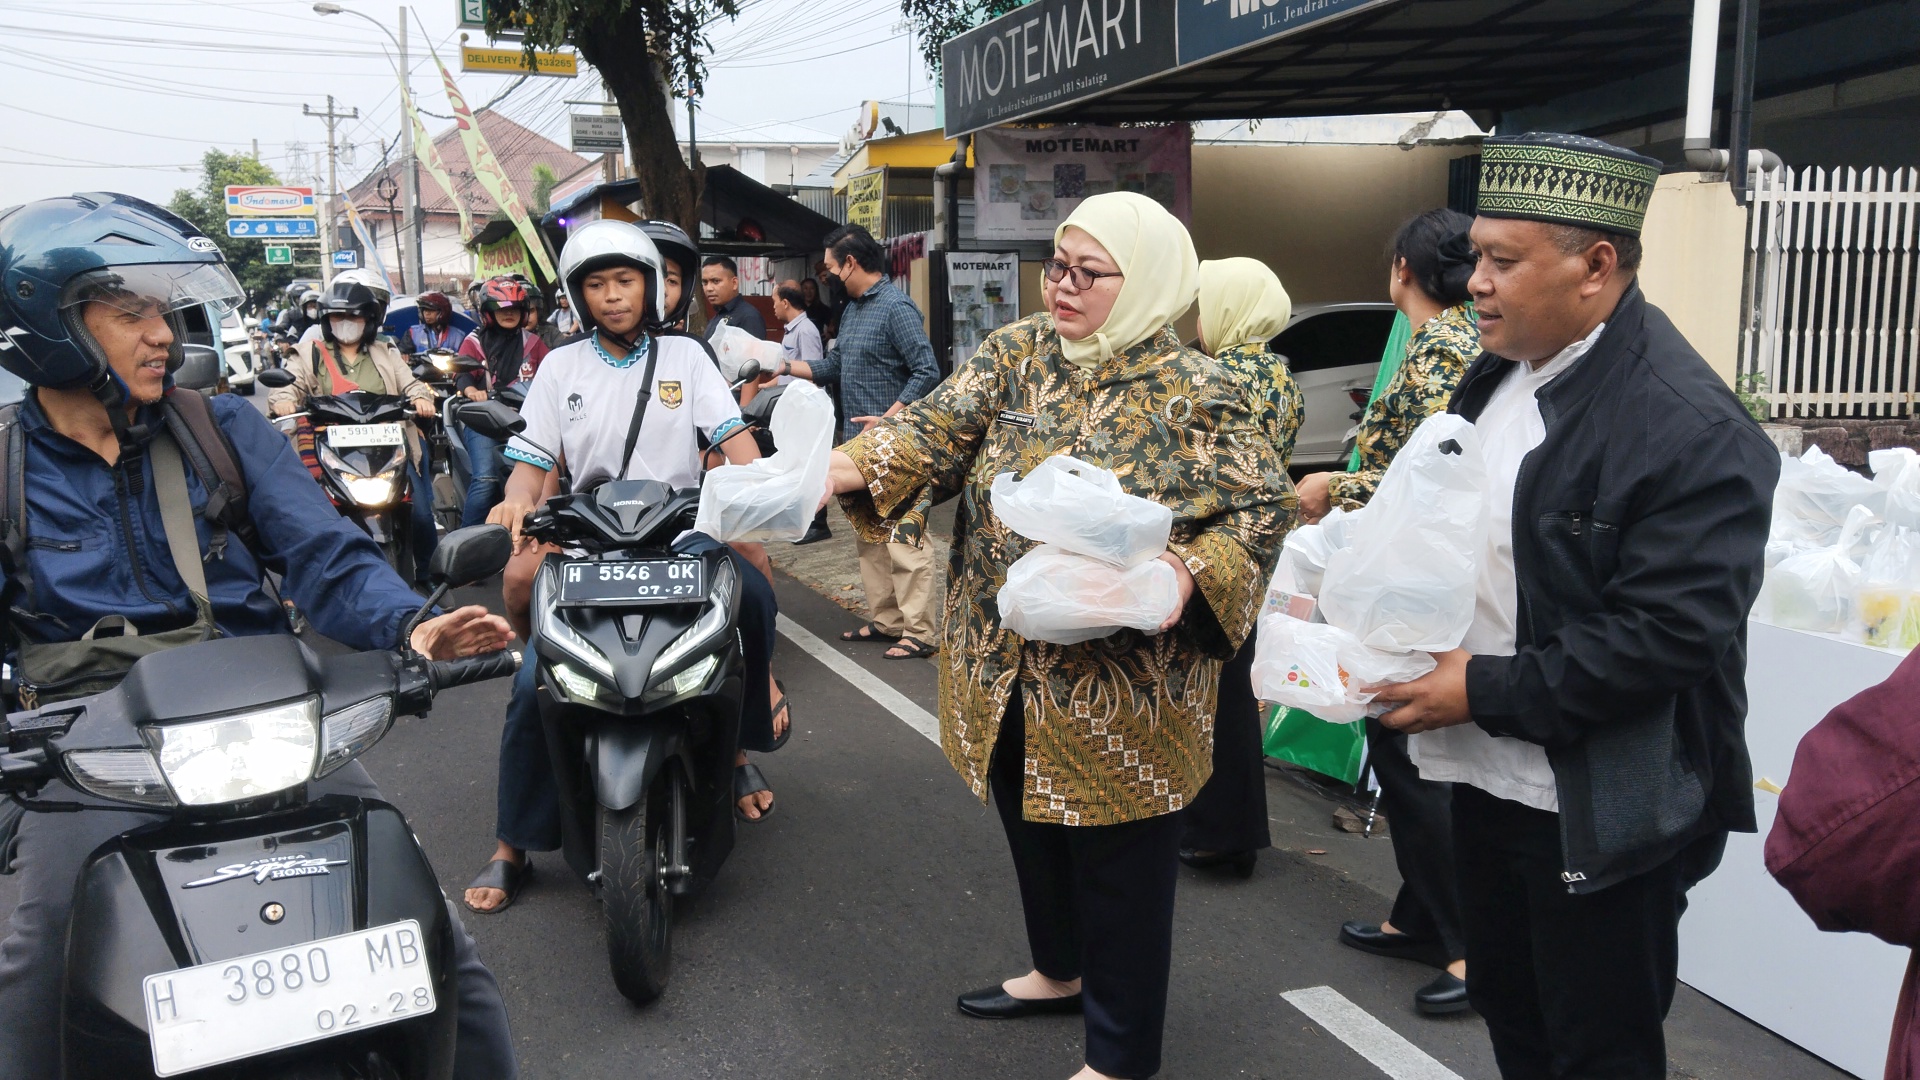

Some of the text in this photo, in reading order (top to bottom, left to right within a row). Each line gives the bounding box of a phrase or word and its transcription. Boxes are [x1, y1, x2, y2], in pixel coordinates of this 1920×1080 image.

[1262, 12, 1281, 30] JL.
[467, 54, 517, 64] DELIVERY
[998, 99, 1020, 116] Jendral
[1021, 92, 1052, 107] Sudirman
[1053, 89, 1061, 98] no
[1062, 81, 1074, 95] 181
[1076, 73, 1108, 90] Salatiga
[1025, 138, 1141, 154] MOTEMART
[243, 195, 298, 205] Indomaret
[952, 262, 1012, 271] MOTEMART
[569, 414, 587, 423] MILLS
[330, 425, 400, 436] H 5991 KK
[613, 499, 645, 508] HONDA
[568, 566, 581, 583] H
[599, 565, 650, 581] 5546
[250, 855, 305, 865] ASTREA
[271, 865, 330, 879] HONDA
[151, 928, 420, 1021] H 3880 MB
